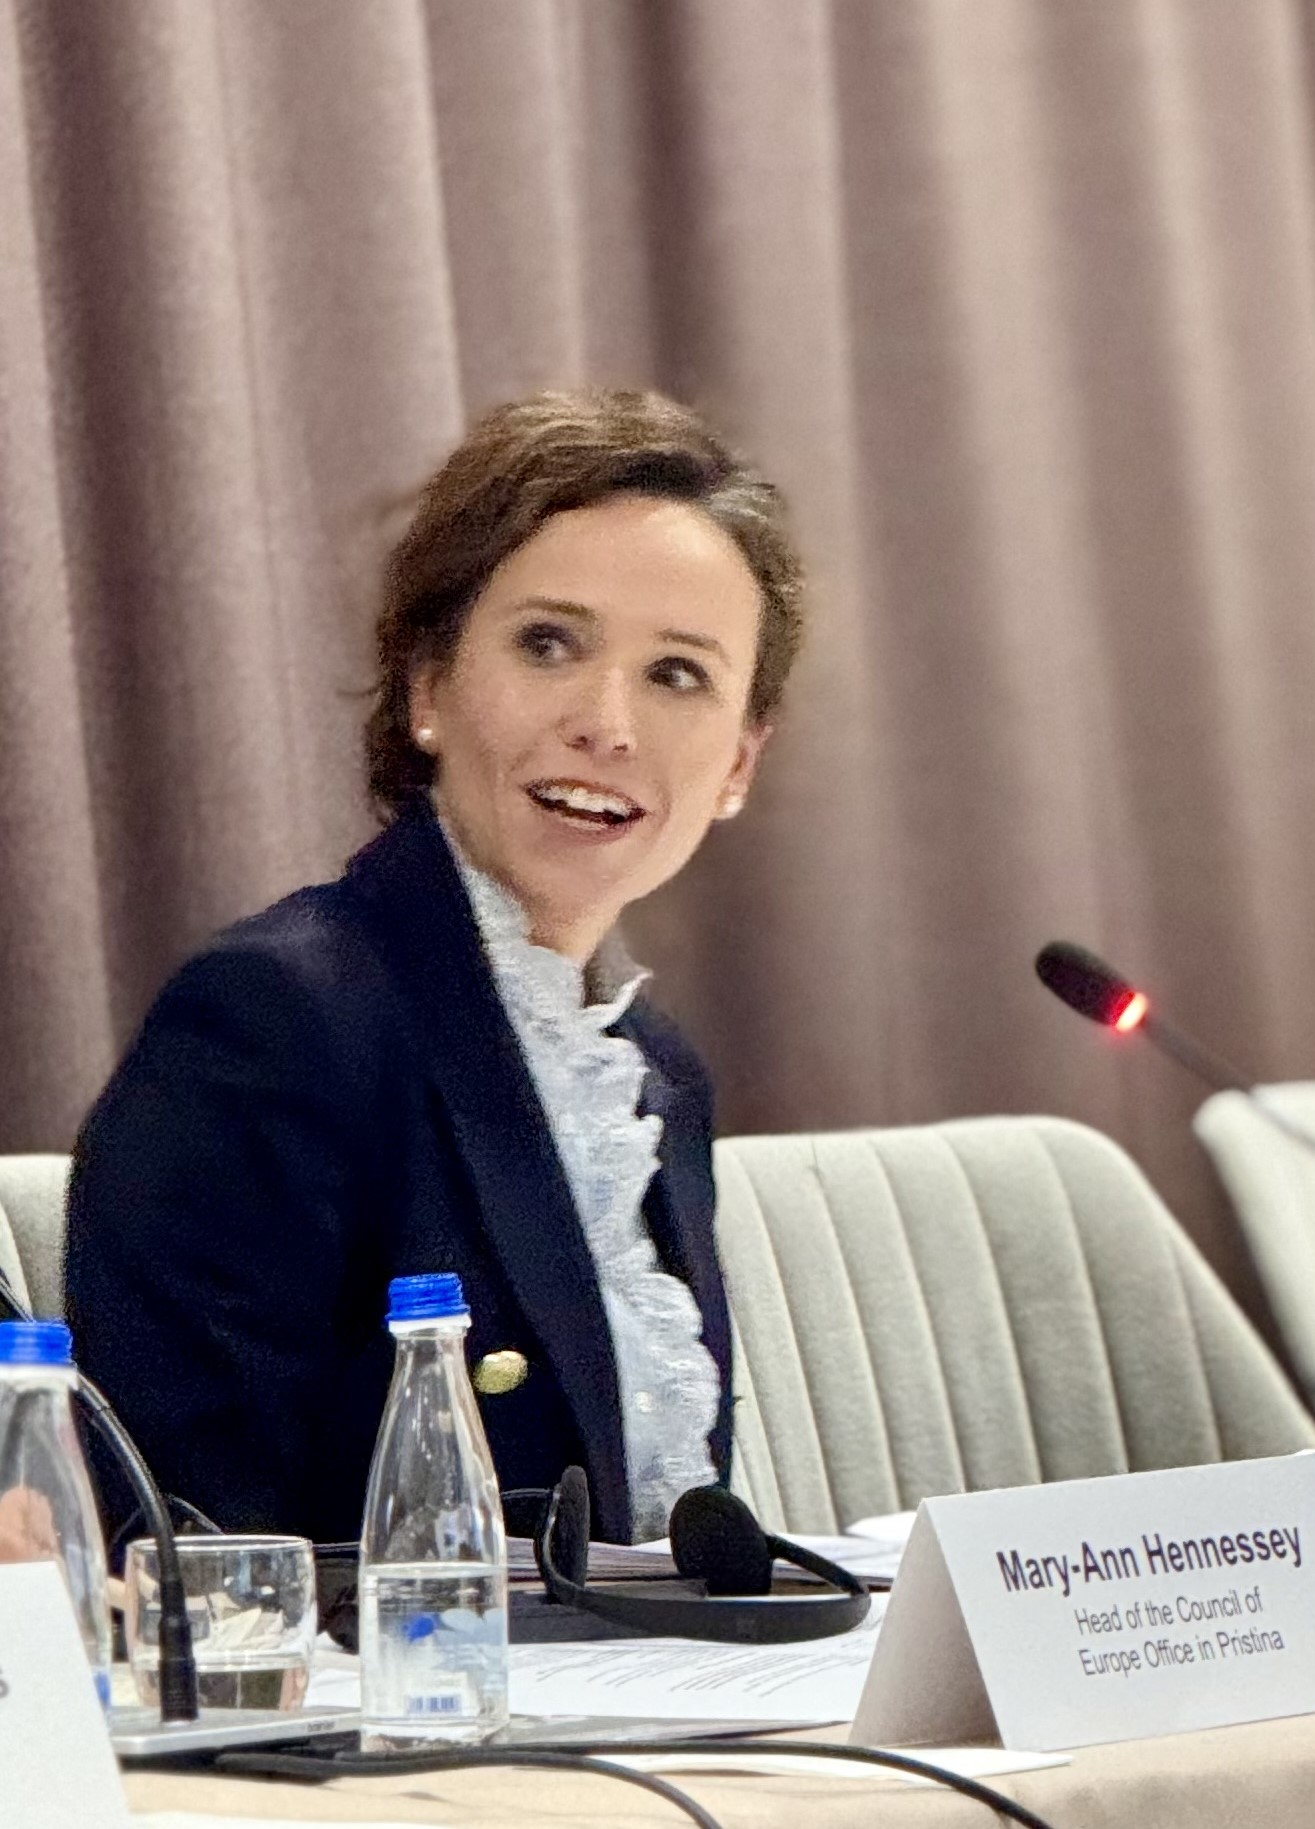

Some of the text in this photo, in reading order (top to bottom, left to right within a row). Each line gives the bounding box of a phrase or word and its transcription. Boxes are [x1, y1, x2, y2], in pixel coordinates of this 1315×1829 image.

[996, 1526, 1301, 1597] Mary-Ann Hennessey
[1075, 1586, 1264, 1635] Head of the Council of
[1079, 1629, 1285, 1678] Europe Office in Pristina
